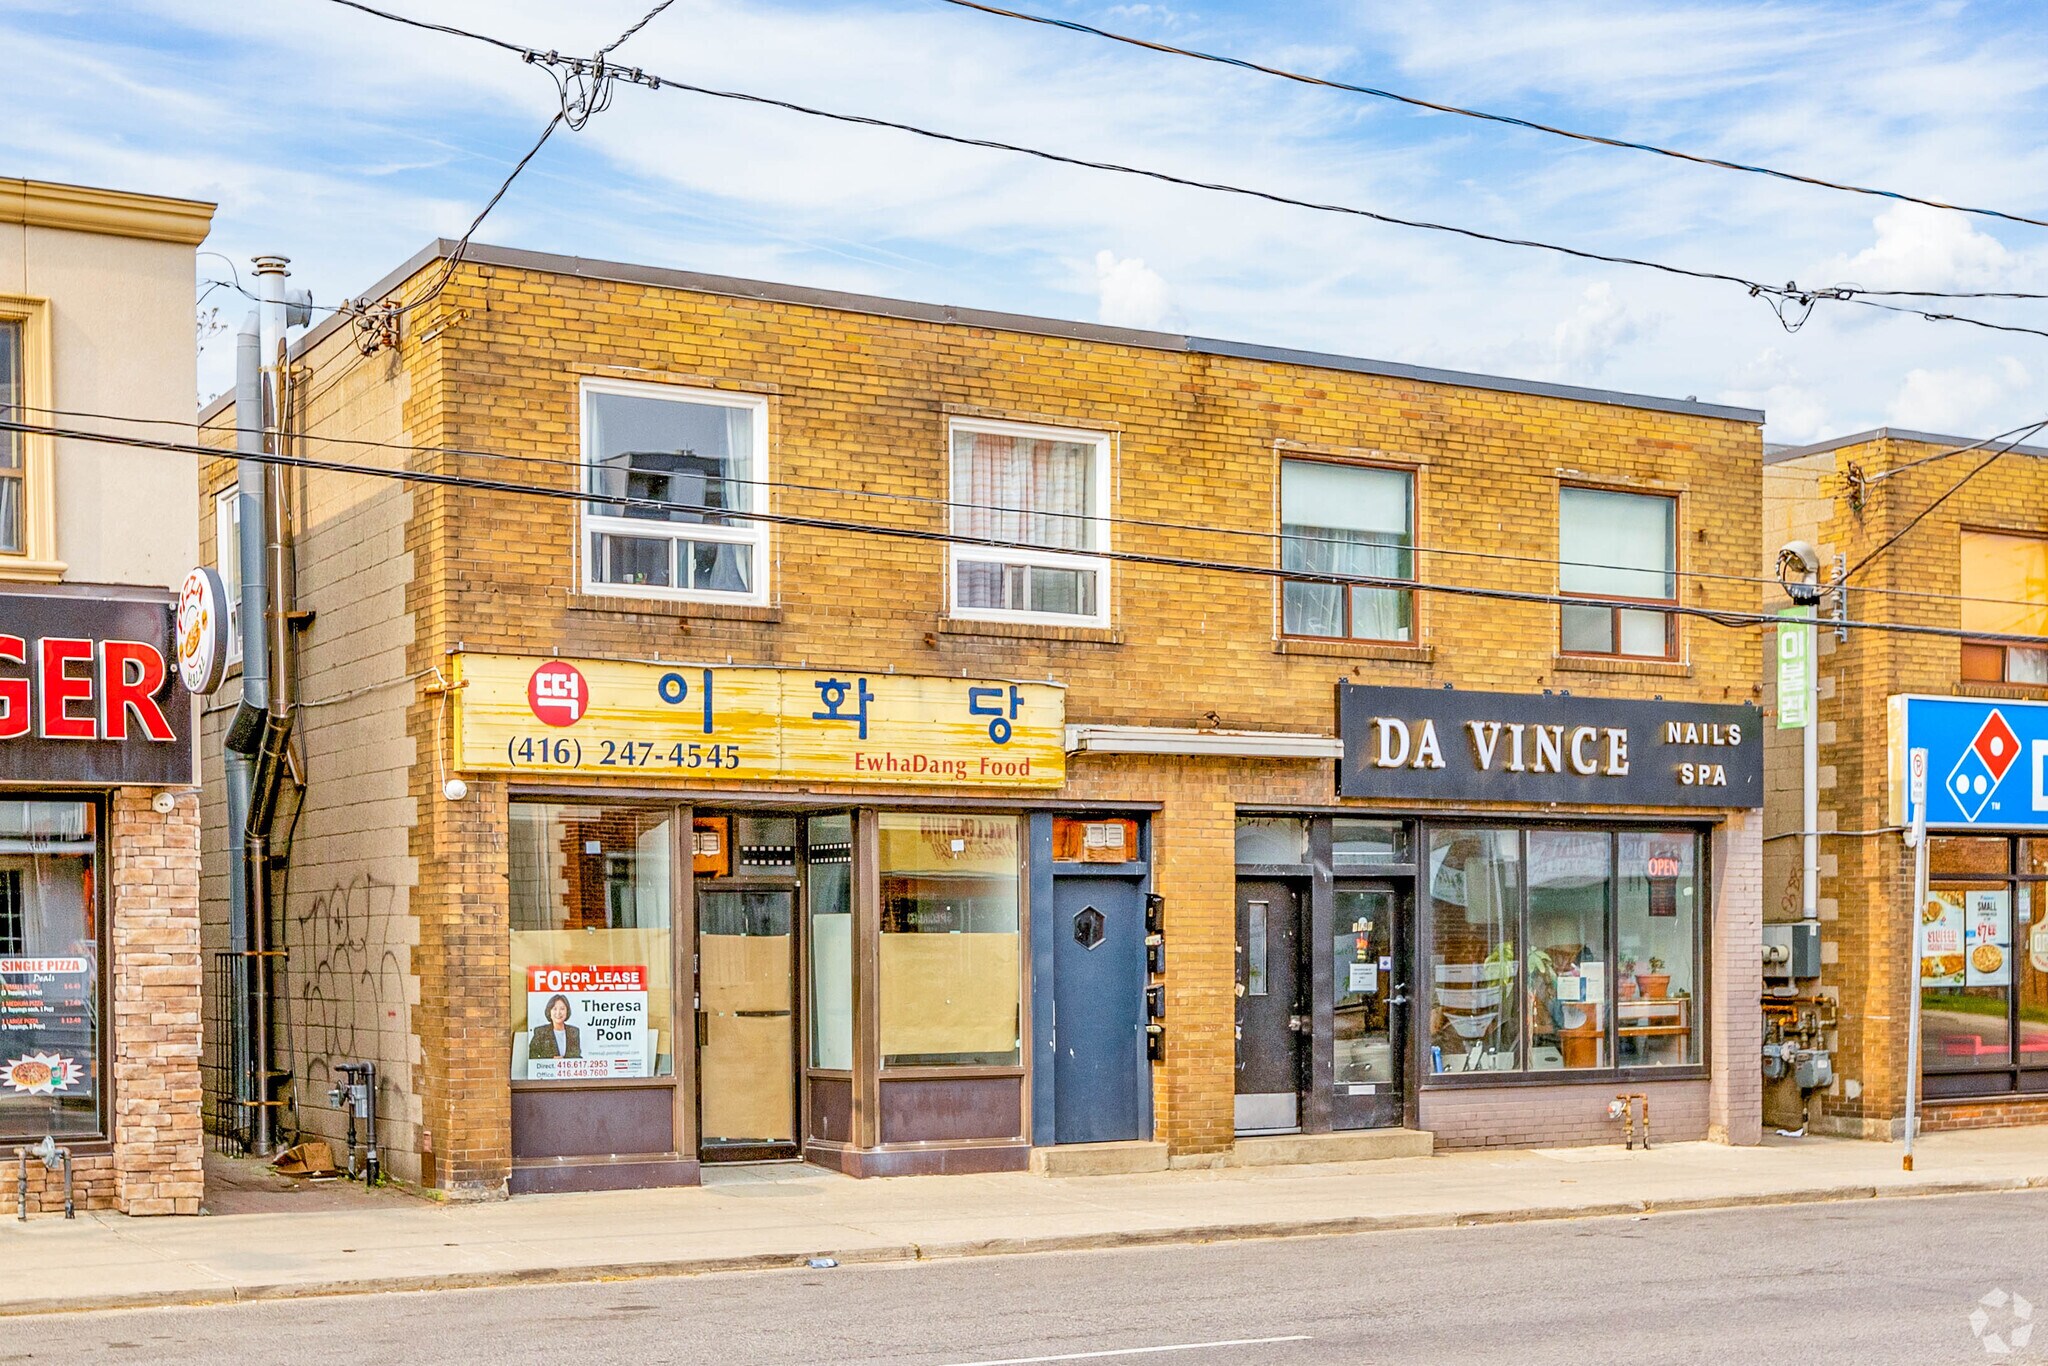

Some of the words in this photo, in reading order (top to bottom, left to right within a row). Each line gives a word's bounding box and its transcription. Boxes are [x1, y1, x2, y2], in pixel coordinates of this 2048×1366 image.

[536, 672, 579, 720] 떡
[1666, 720, 1742, 746] NAILS
[1376, 716, 1446, 769] DA
[1469, 720, 1630, 776] VINCE
[508, 736, 582, 768] (416)
[600, 740, 740, 770] 247-4545
[855, 752, 968, 780] EwhaDang
[980, 757, 1031, 776] Food
[1681, 763, 1727, 786] SPA
[1648, 857, 1678, 876] OPEN
[1977, 901, 1997, 911] SMALL
[1, 960, 44, 972] SINGLE
[47, 960, 80, 971] PIZZA
[33, 973, 55, 983] Deals
[562, 972, 590, 983] FOR
[596, 972, 640, 983] LEASE
[581, 1000, 641, 1012] Theresa
[587, 1016, 636, 1029] Junglim
[597, 1029, 632, 1041] Poon
[557, 1060, 608, 1069] 416.617.2953
[557, 1069, 608, 1078] 416.449.7600
